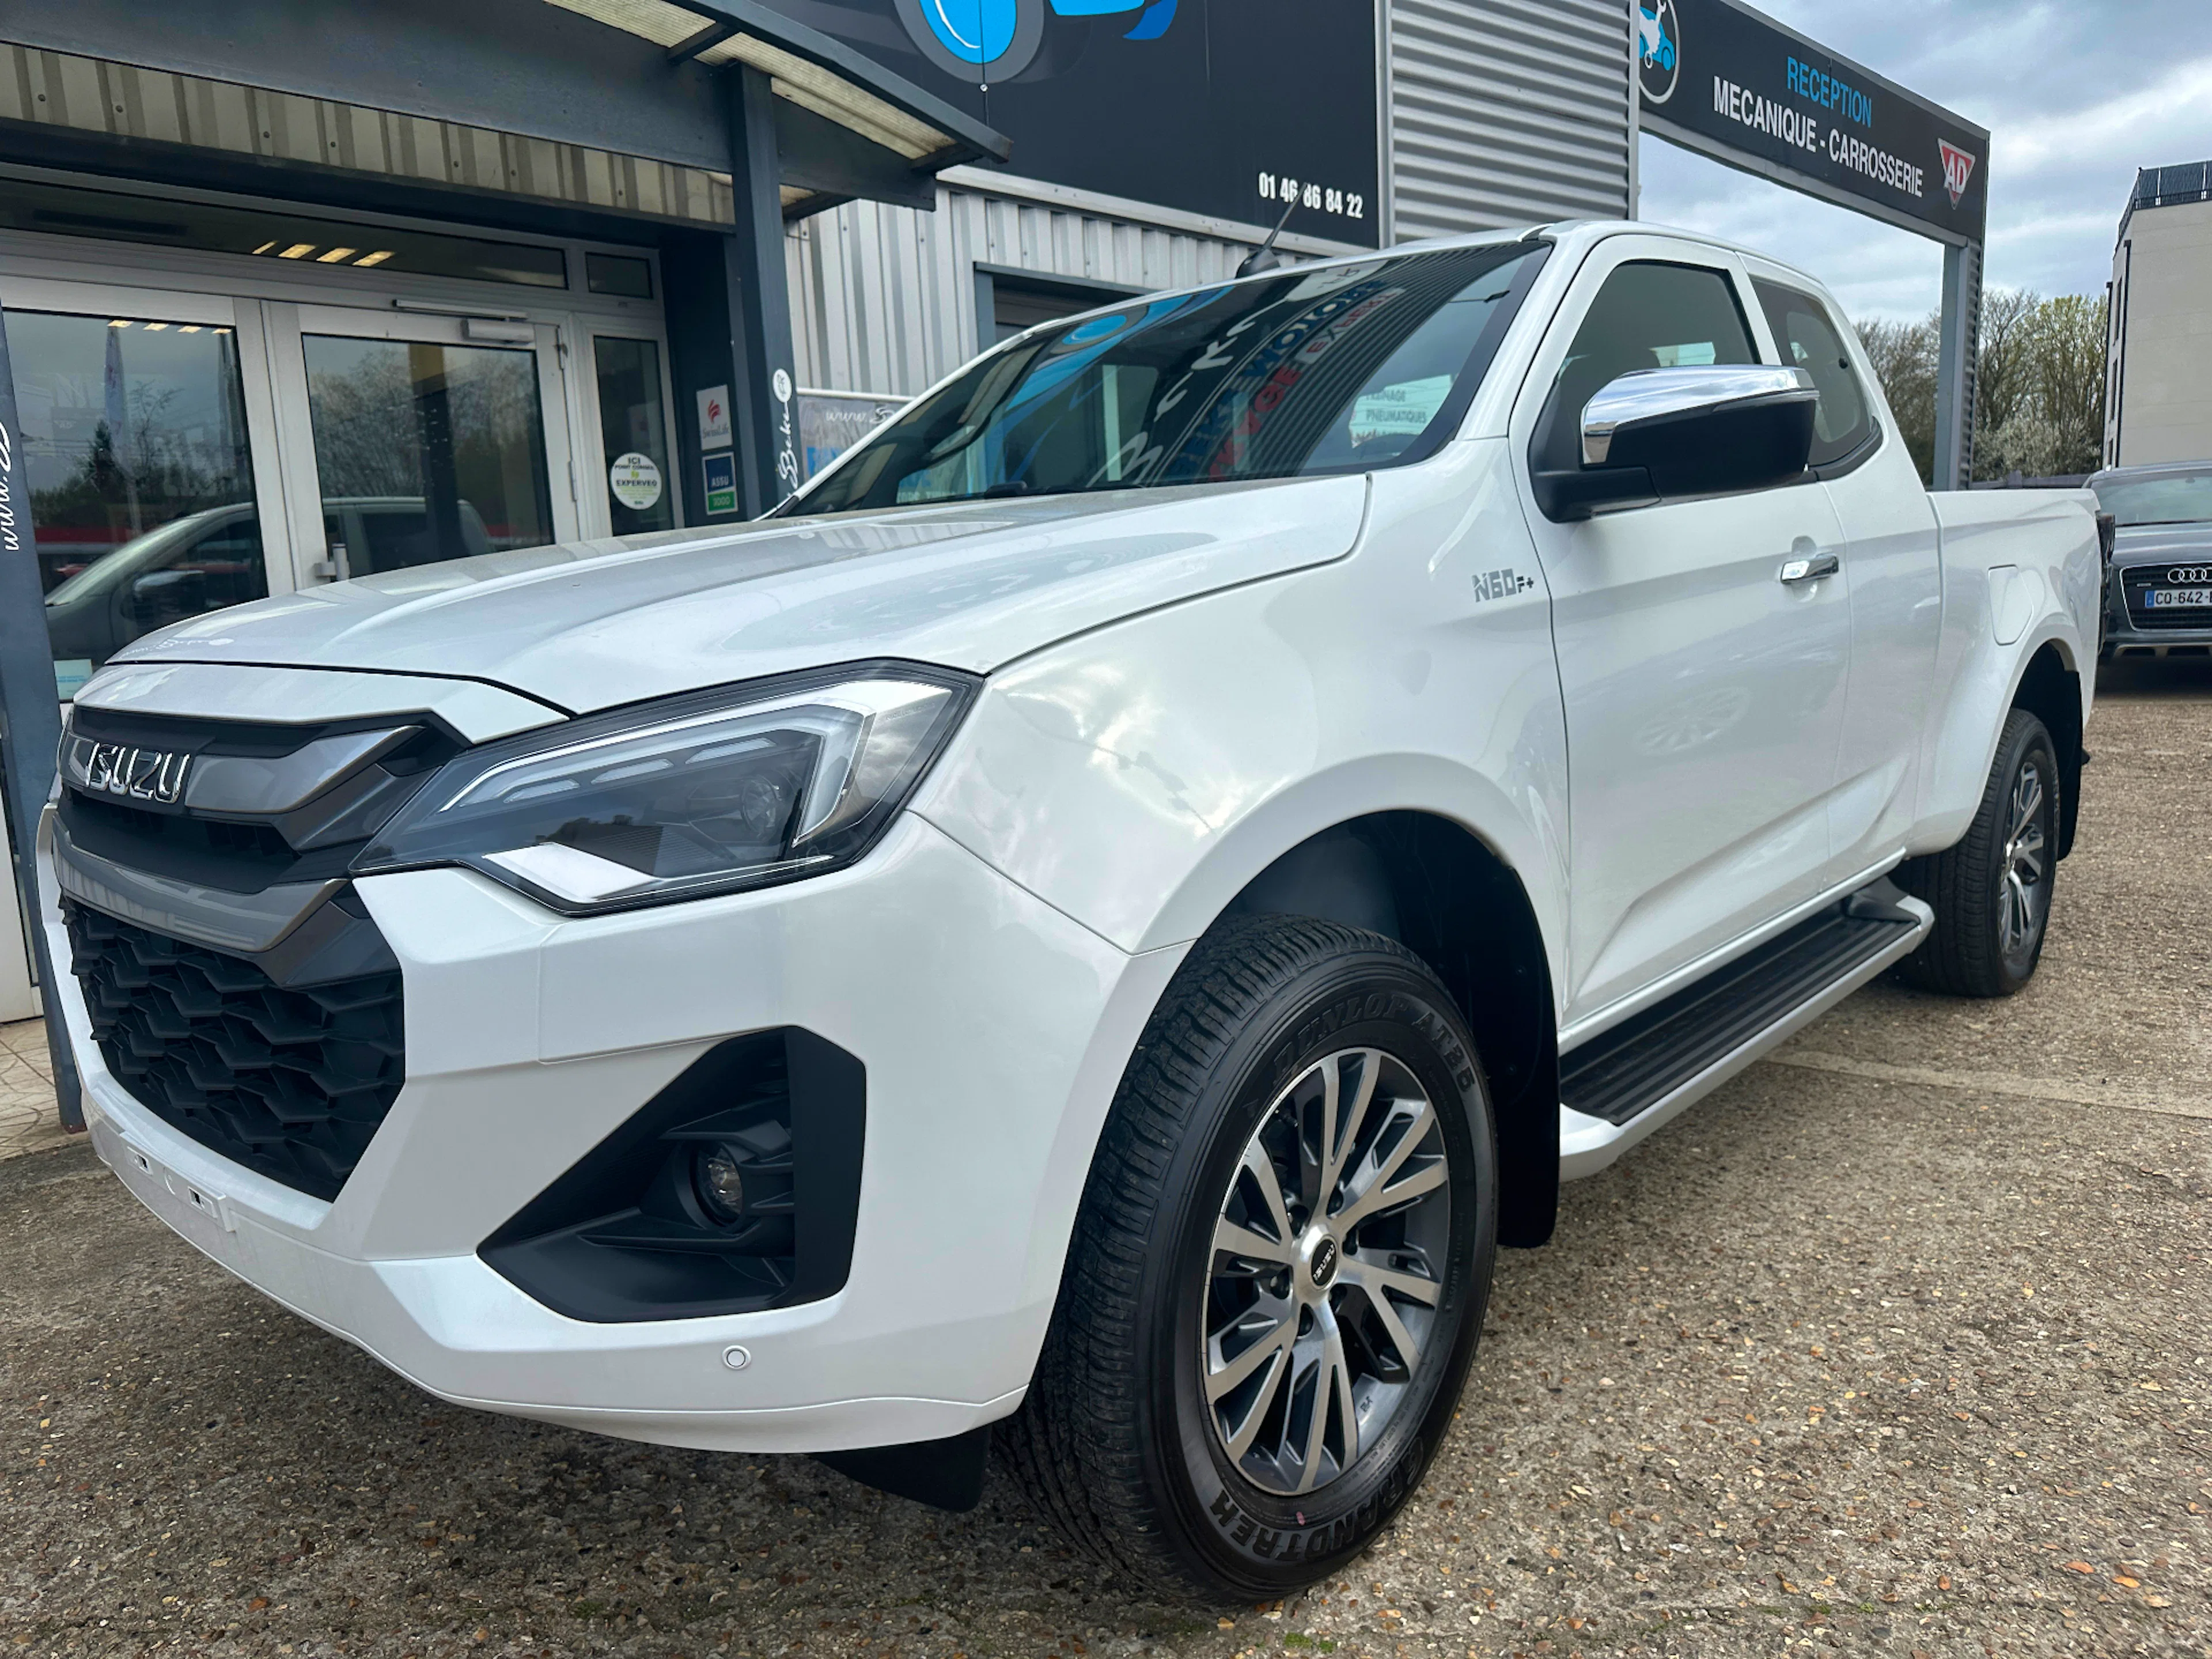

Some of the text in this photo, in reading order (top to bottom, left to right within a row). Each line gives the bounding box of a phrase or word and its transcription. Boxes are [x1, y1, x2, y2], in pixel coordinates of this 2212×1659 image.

[1787, 56, 1872, 128] RECEPTION
[1713, 75, 1817, 153] MECANIQUE
[1828, 128, 1923, 198] CARROSSERIE
[1259, 172, 1276, 199] 01
[1325, 188, 1343, 214] 84
[1346, 193, 1363, 219] 22
[1944, 151, 1968, 195] AD
[710, 474, 730, 488] ASSU
[85, 741, 191, 805] ISUZU
[1272, 992, 1412, 1087] DUNLOP
[1313, 1243, 1336, 1281] ISUZU
[1209, 1443, 1425, 1561] GRANDTREK
